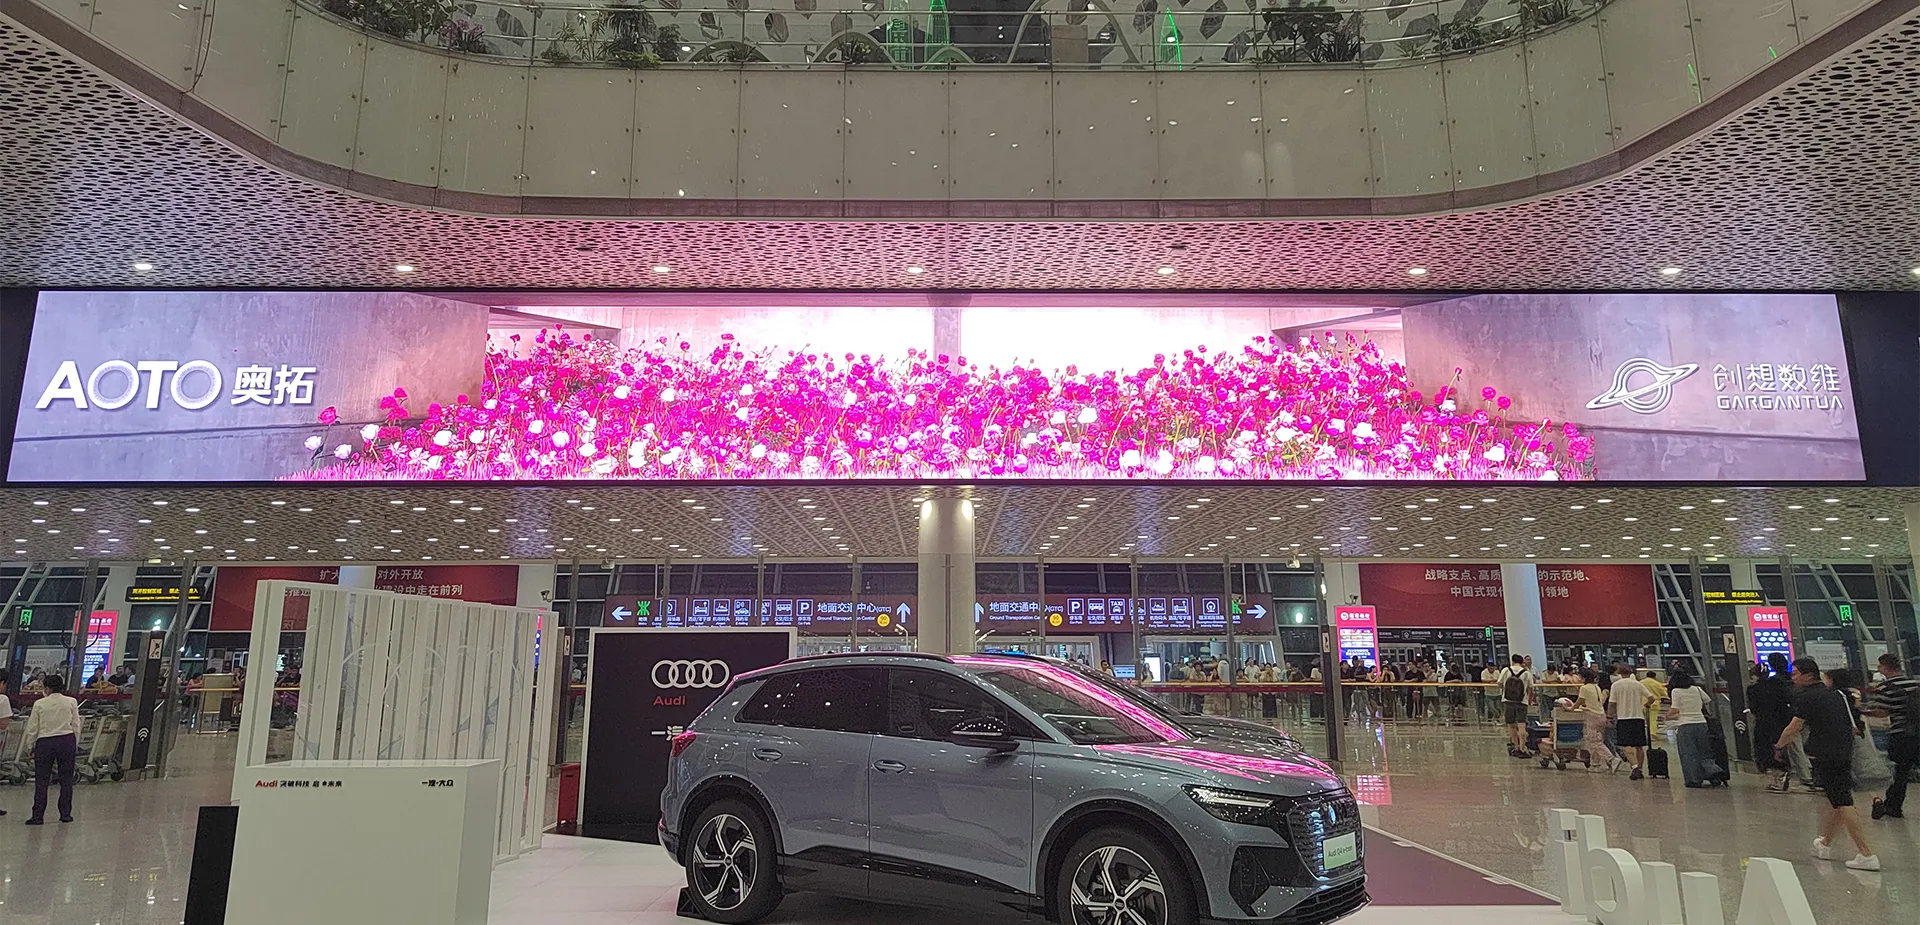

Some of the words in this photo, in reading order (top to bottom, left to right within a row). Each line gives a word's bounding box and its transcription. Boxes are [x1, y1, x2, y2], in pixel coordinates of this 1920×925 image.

[35, 359, 222, 410] AOTO
[231, 364, 317, 405] 奥拓
[1713, 363, 1840, 391] 创想数维
[1717, 395, 1844, 410] GARGANTUA
[653, 695, 686, 706] Audi
